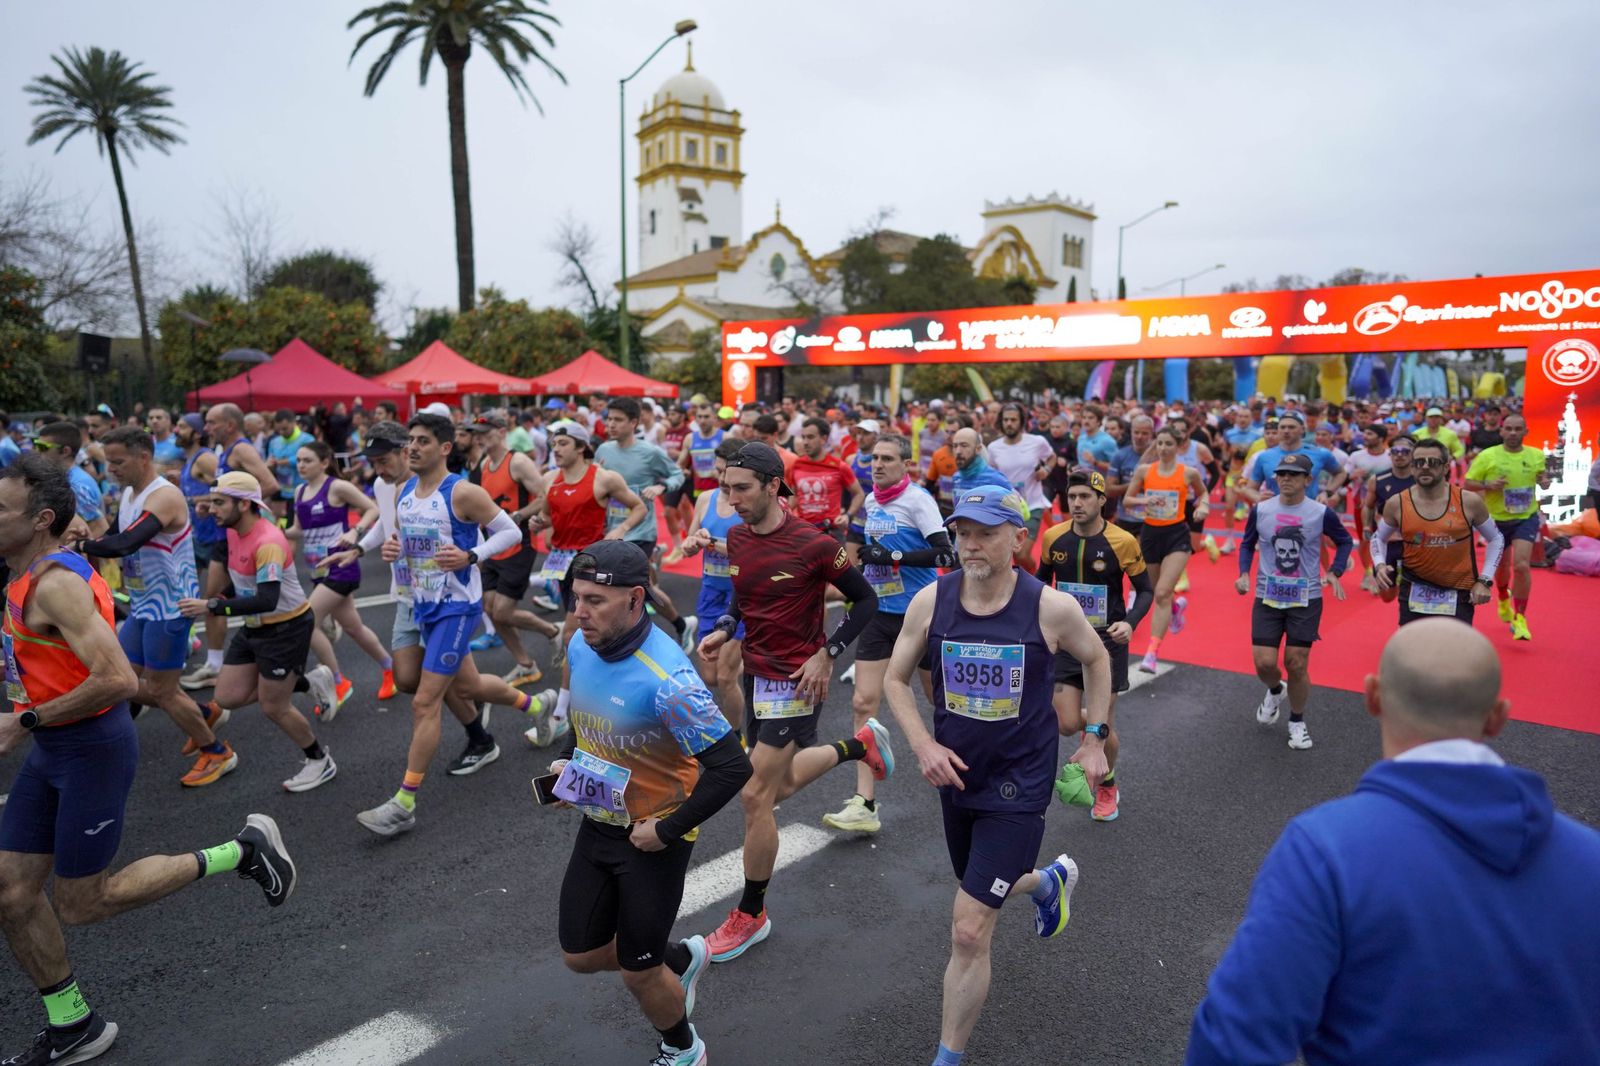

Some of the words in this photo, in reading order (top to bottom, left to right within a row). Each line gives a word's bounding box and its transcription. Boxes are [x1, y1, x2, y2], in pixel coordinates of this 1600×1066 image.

[405, 537, 431, 551] 1738
[1271, 584, 1299, 598] 3846
[953, 661, 1004, 687] 3958
[566, 768, 606, 800] 2161
